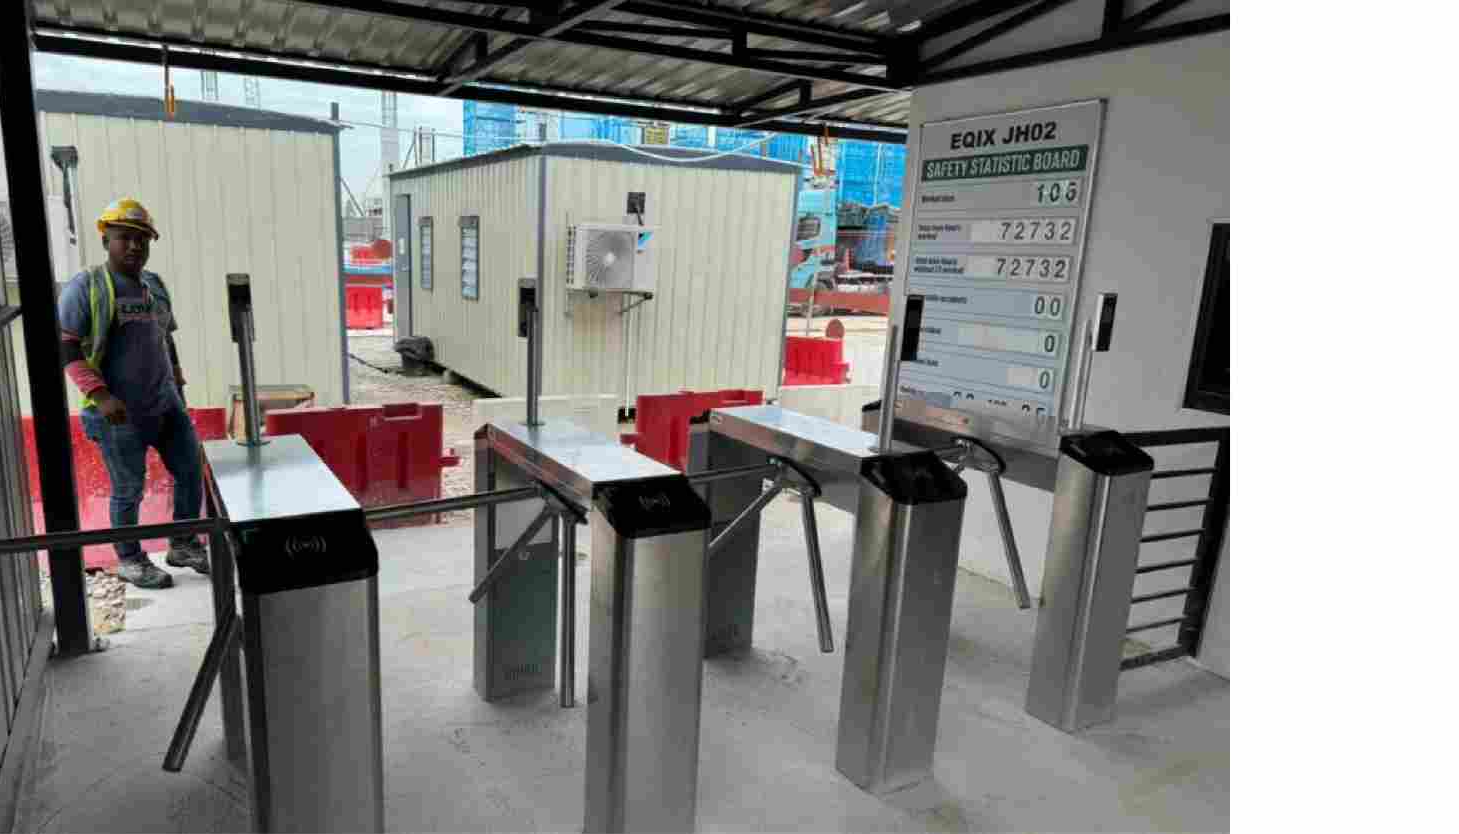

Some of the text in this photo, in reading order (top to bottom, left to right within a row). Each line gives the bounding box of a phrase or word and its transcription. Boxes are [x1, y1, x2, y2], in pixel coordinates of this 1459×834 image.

[950, 121, 1057, 150] EQIX JH02
[926, 150, 1080, 179] SAFETY STATISTIC BOARD
[1000, 221, 1072, 241] 72732
[997, 258, 1067, 279] 72732
